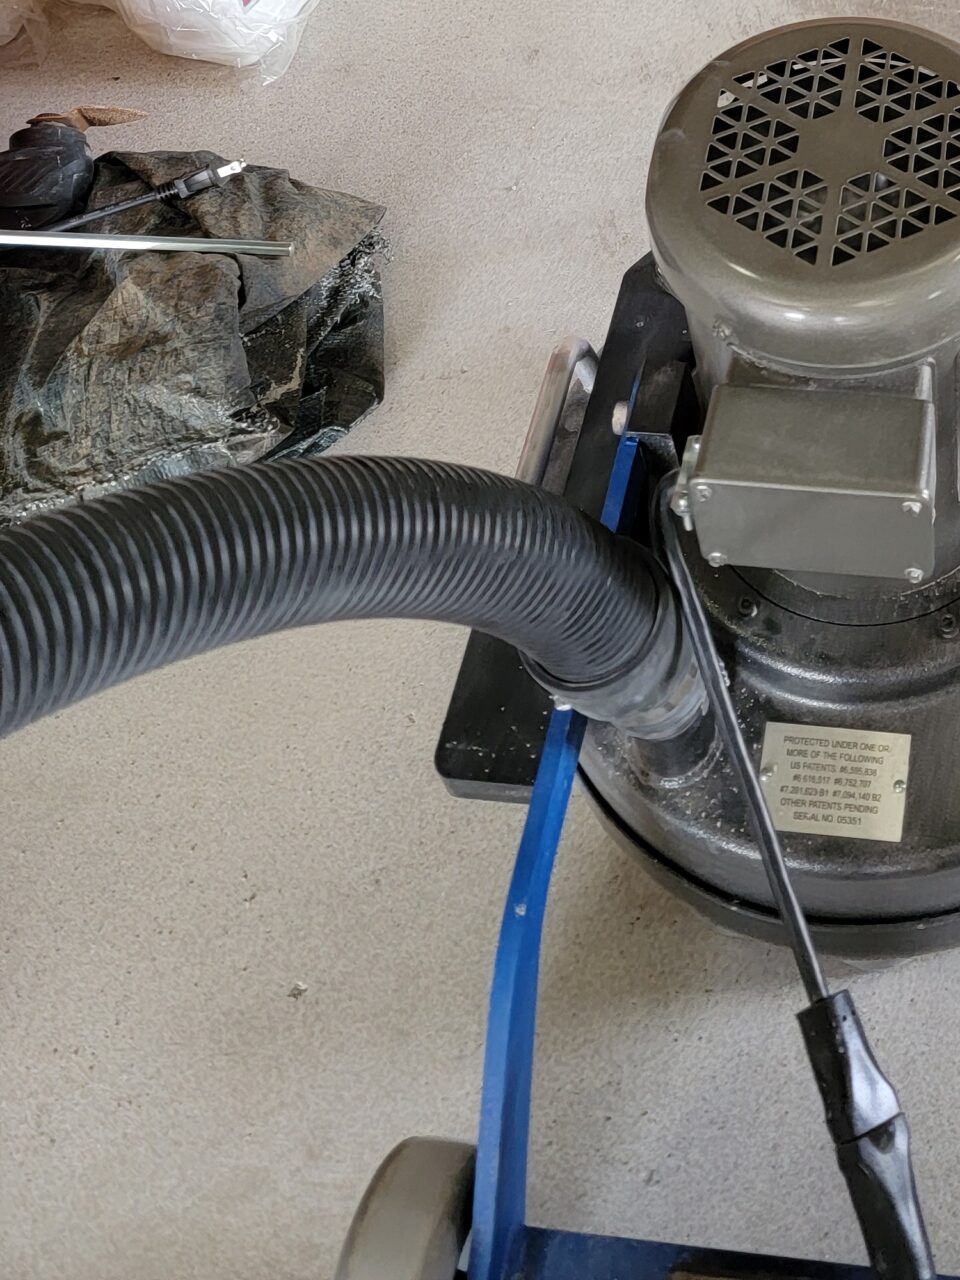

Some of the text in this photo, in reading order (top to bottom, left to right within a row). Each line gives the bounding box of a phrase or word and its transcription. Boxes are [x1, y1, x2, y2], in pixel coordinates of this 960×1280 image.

[784, 736, 890, 753] PROTECTED UNDER ONE OR
[786, 748, 884, 765] MORE OF THE FOLLOWING
[790, 761, 800, 770] US
[819, 788, 829, 797] B1
[872, 793, 882, 803] B2
[780, 798, 879, 815] OTHER PATENTS PENDING
[793, 811, 821, 822] SERIAL
